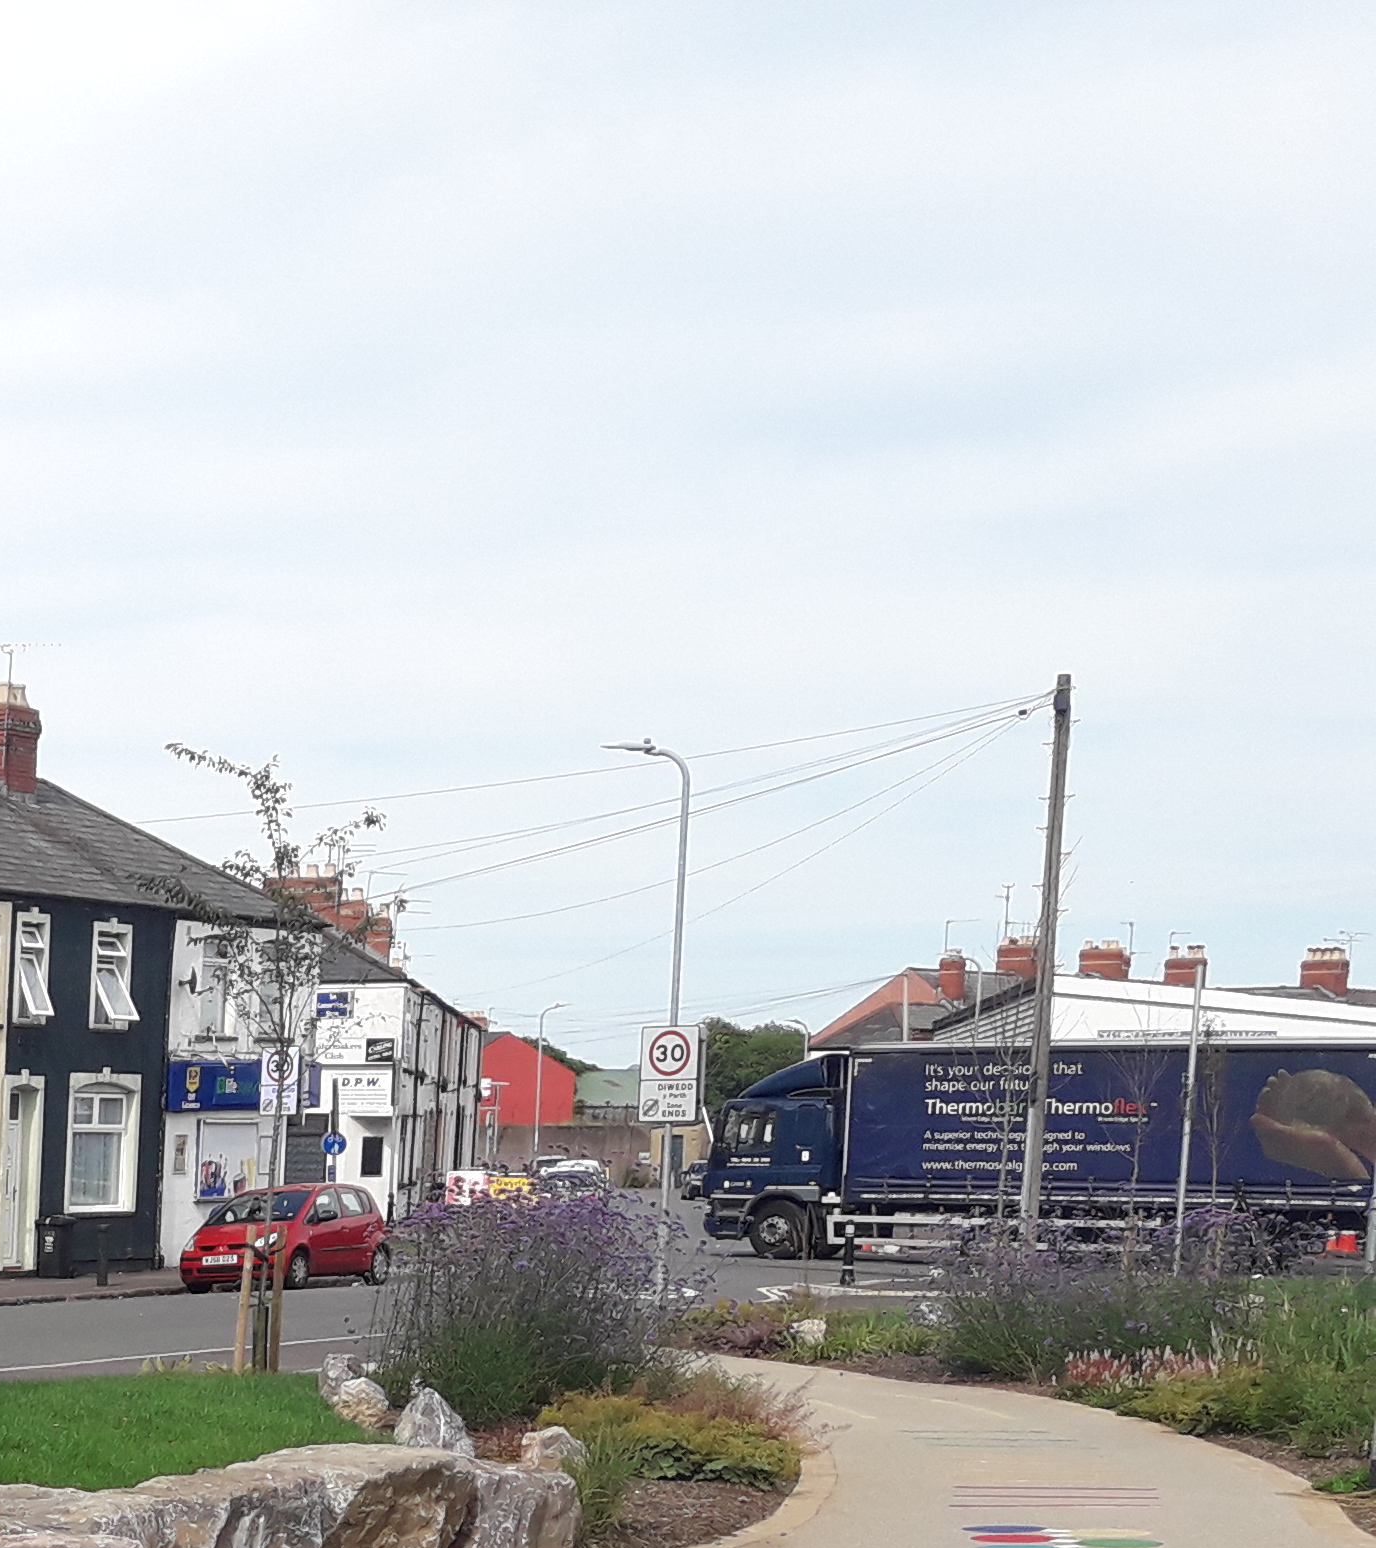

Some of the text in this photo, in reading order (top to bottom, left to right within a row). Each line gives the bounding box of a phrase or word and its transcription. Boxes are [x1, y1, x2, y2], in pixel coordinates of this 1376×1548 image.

[656, 1044, 684, 1062] 30
[925, 1062, 1083, 1079] It's your decsio that
[341, 1077, 381, 1088] D.P.W.
[658, 1083, 694, 1091] DIWEDD
[925, 1077, 1029, 1093] shape our futu
[924, 1098, 1027, 1115] Thermobar
[924, 1130, 932, 1139] A
[934, 1130, 971, 1140] superior
[974, 1130, 1026, 1141] technoogy
[1075, 1131, 1085, 1140] to
[923, 1141, 964, 1151] minimise
[966, 1143, 998, 1153] energy
[1061, 1144, 1084, 1153] your
[1086, 1142, 1131, 1152] windows
[922, 1159, 1078, 1172] www.thermosalgp.com
